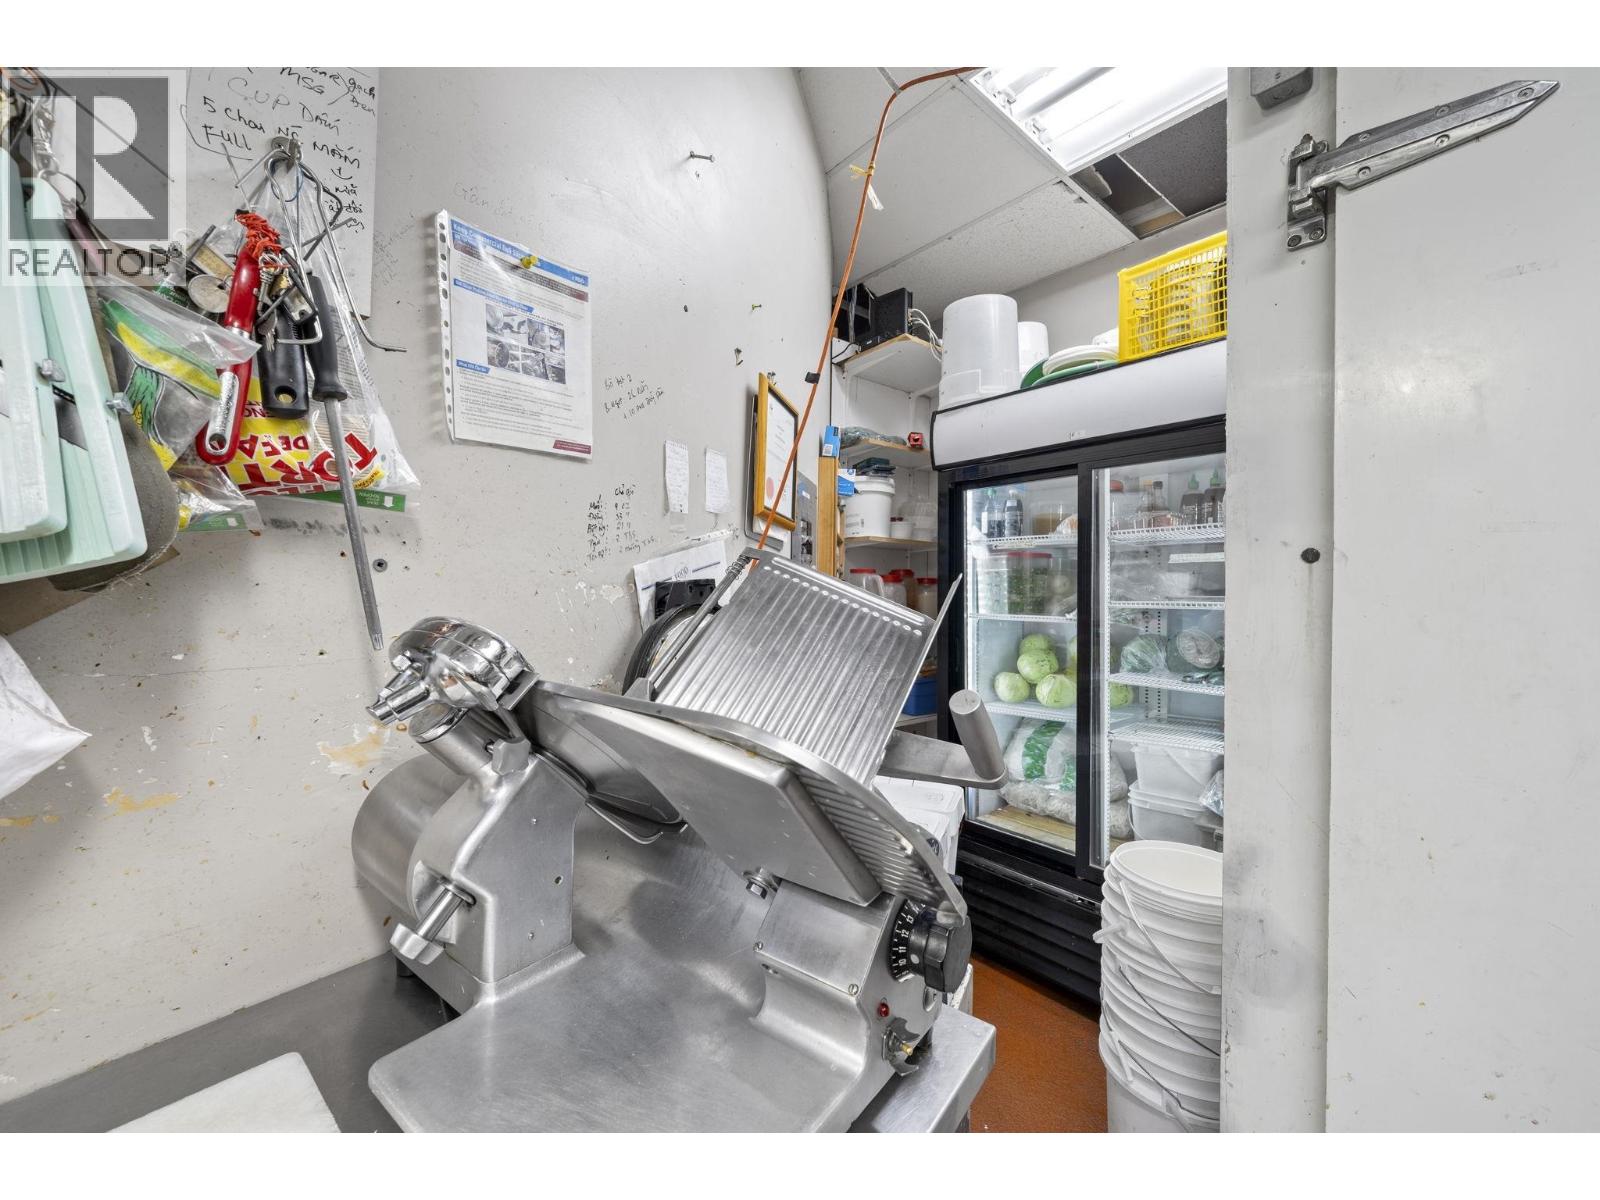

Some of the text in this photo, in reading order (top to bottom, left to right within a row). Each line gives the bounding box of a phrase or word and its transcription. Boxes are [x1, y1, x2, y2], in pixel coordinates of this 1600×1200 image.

[203, 96, 216, 113] 5
[900, 929, 910, 938] 12
[898, 958, 907, 966] 10
